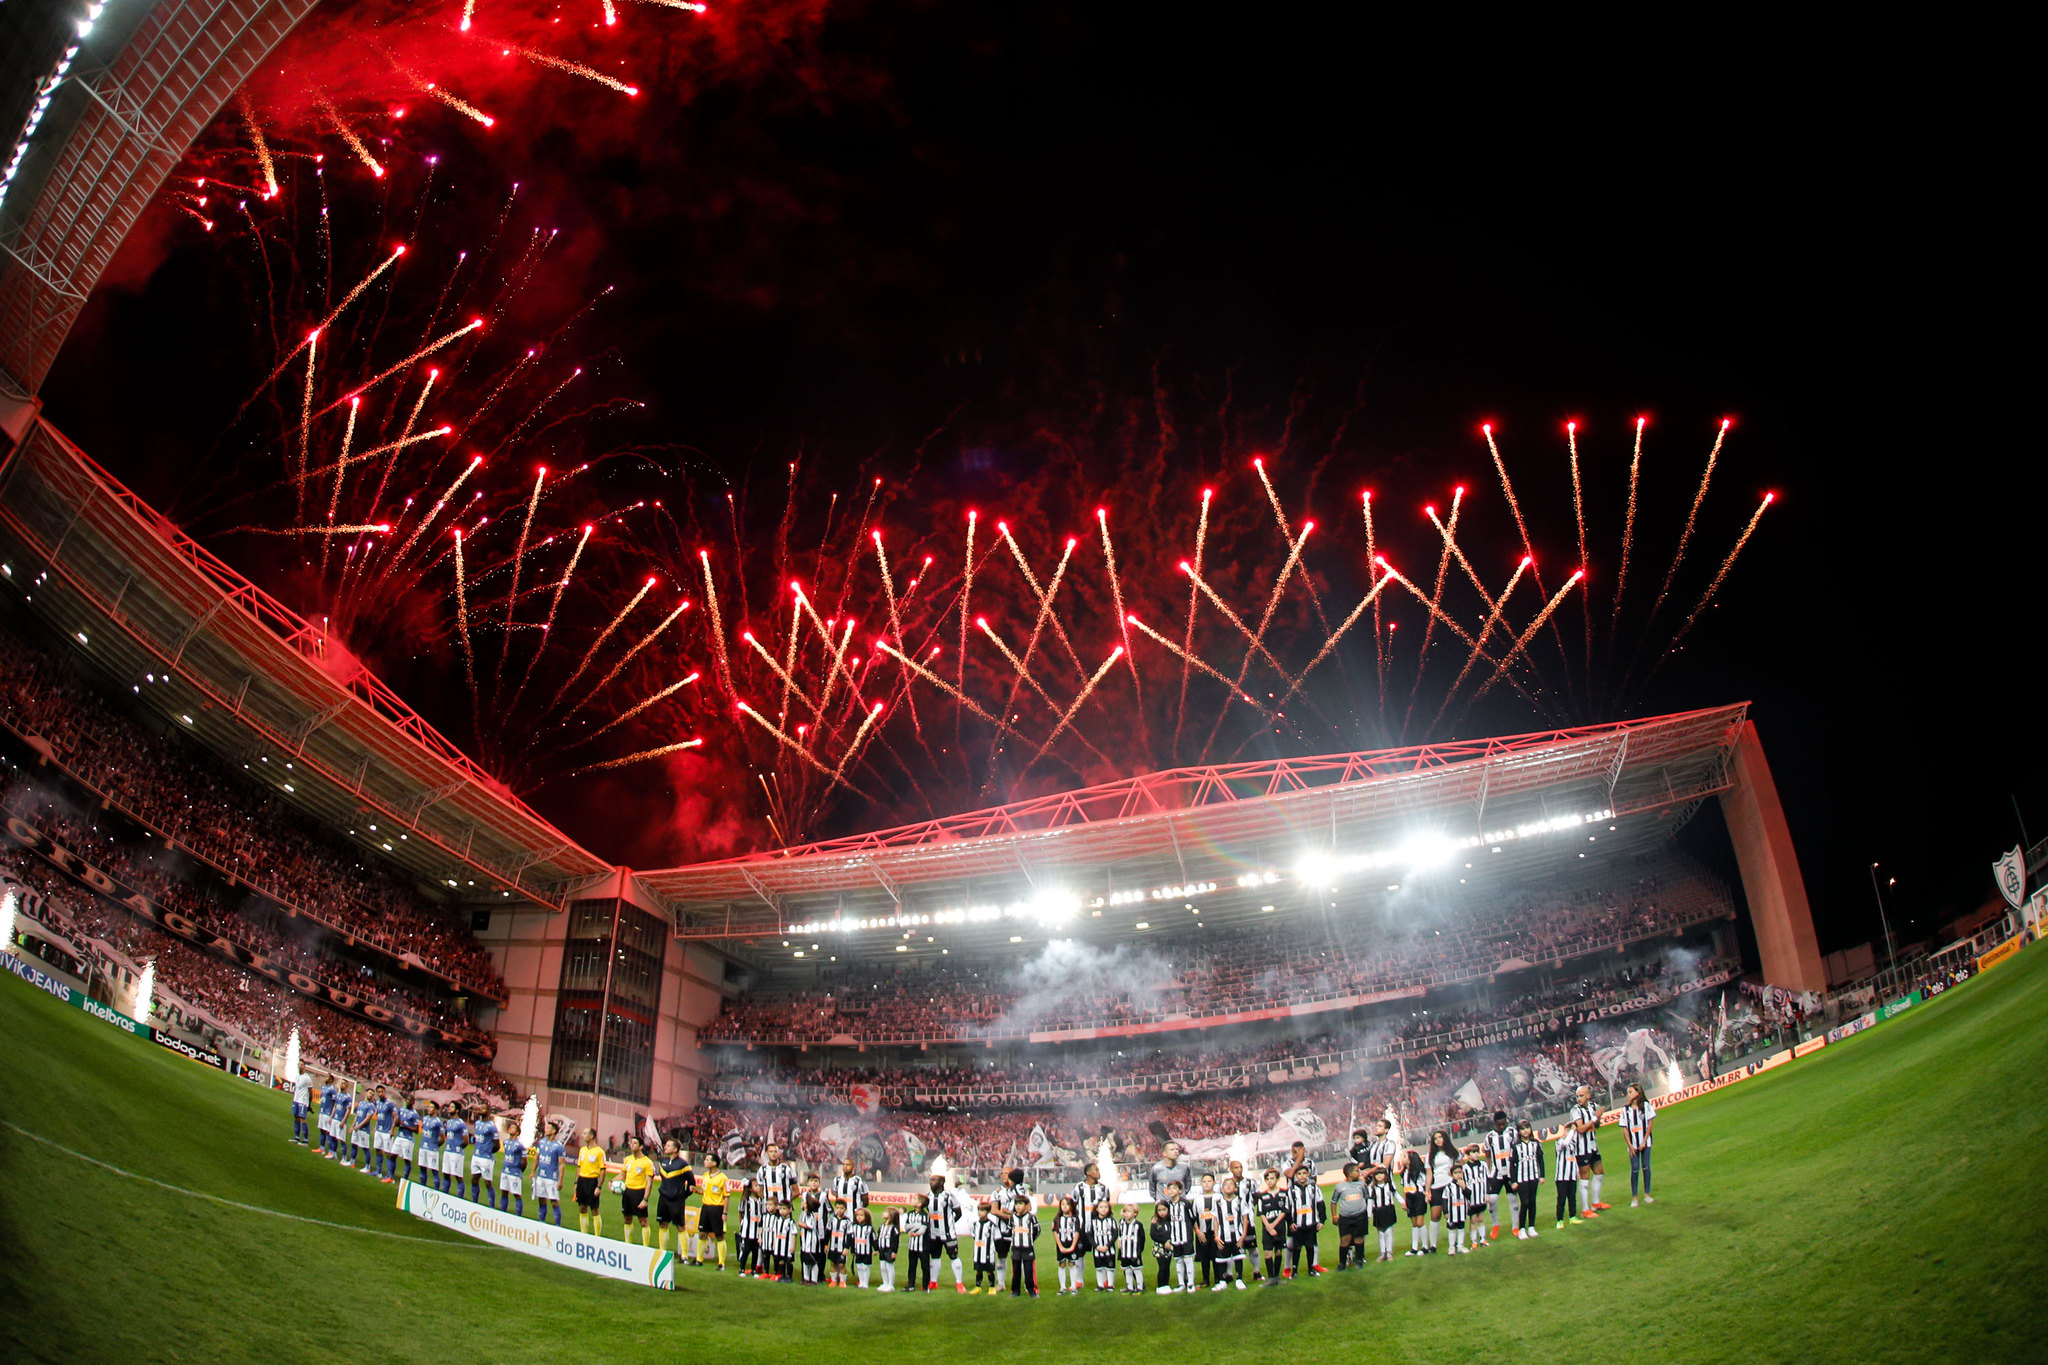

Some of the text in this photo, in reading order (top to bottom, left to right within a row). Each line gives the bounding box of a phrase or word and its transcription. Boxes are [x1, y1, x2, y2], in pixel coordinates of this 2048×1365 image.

[27, 968, 71, 1002] JEANS
[83, 997, 136, 1033] intelbras
[155, 1030, 221, 1066] bodog.net
[441, 1202, 632, 1272] Copa Continental do BRASIL
